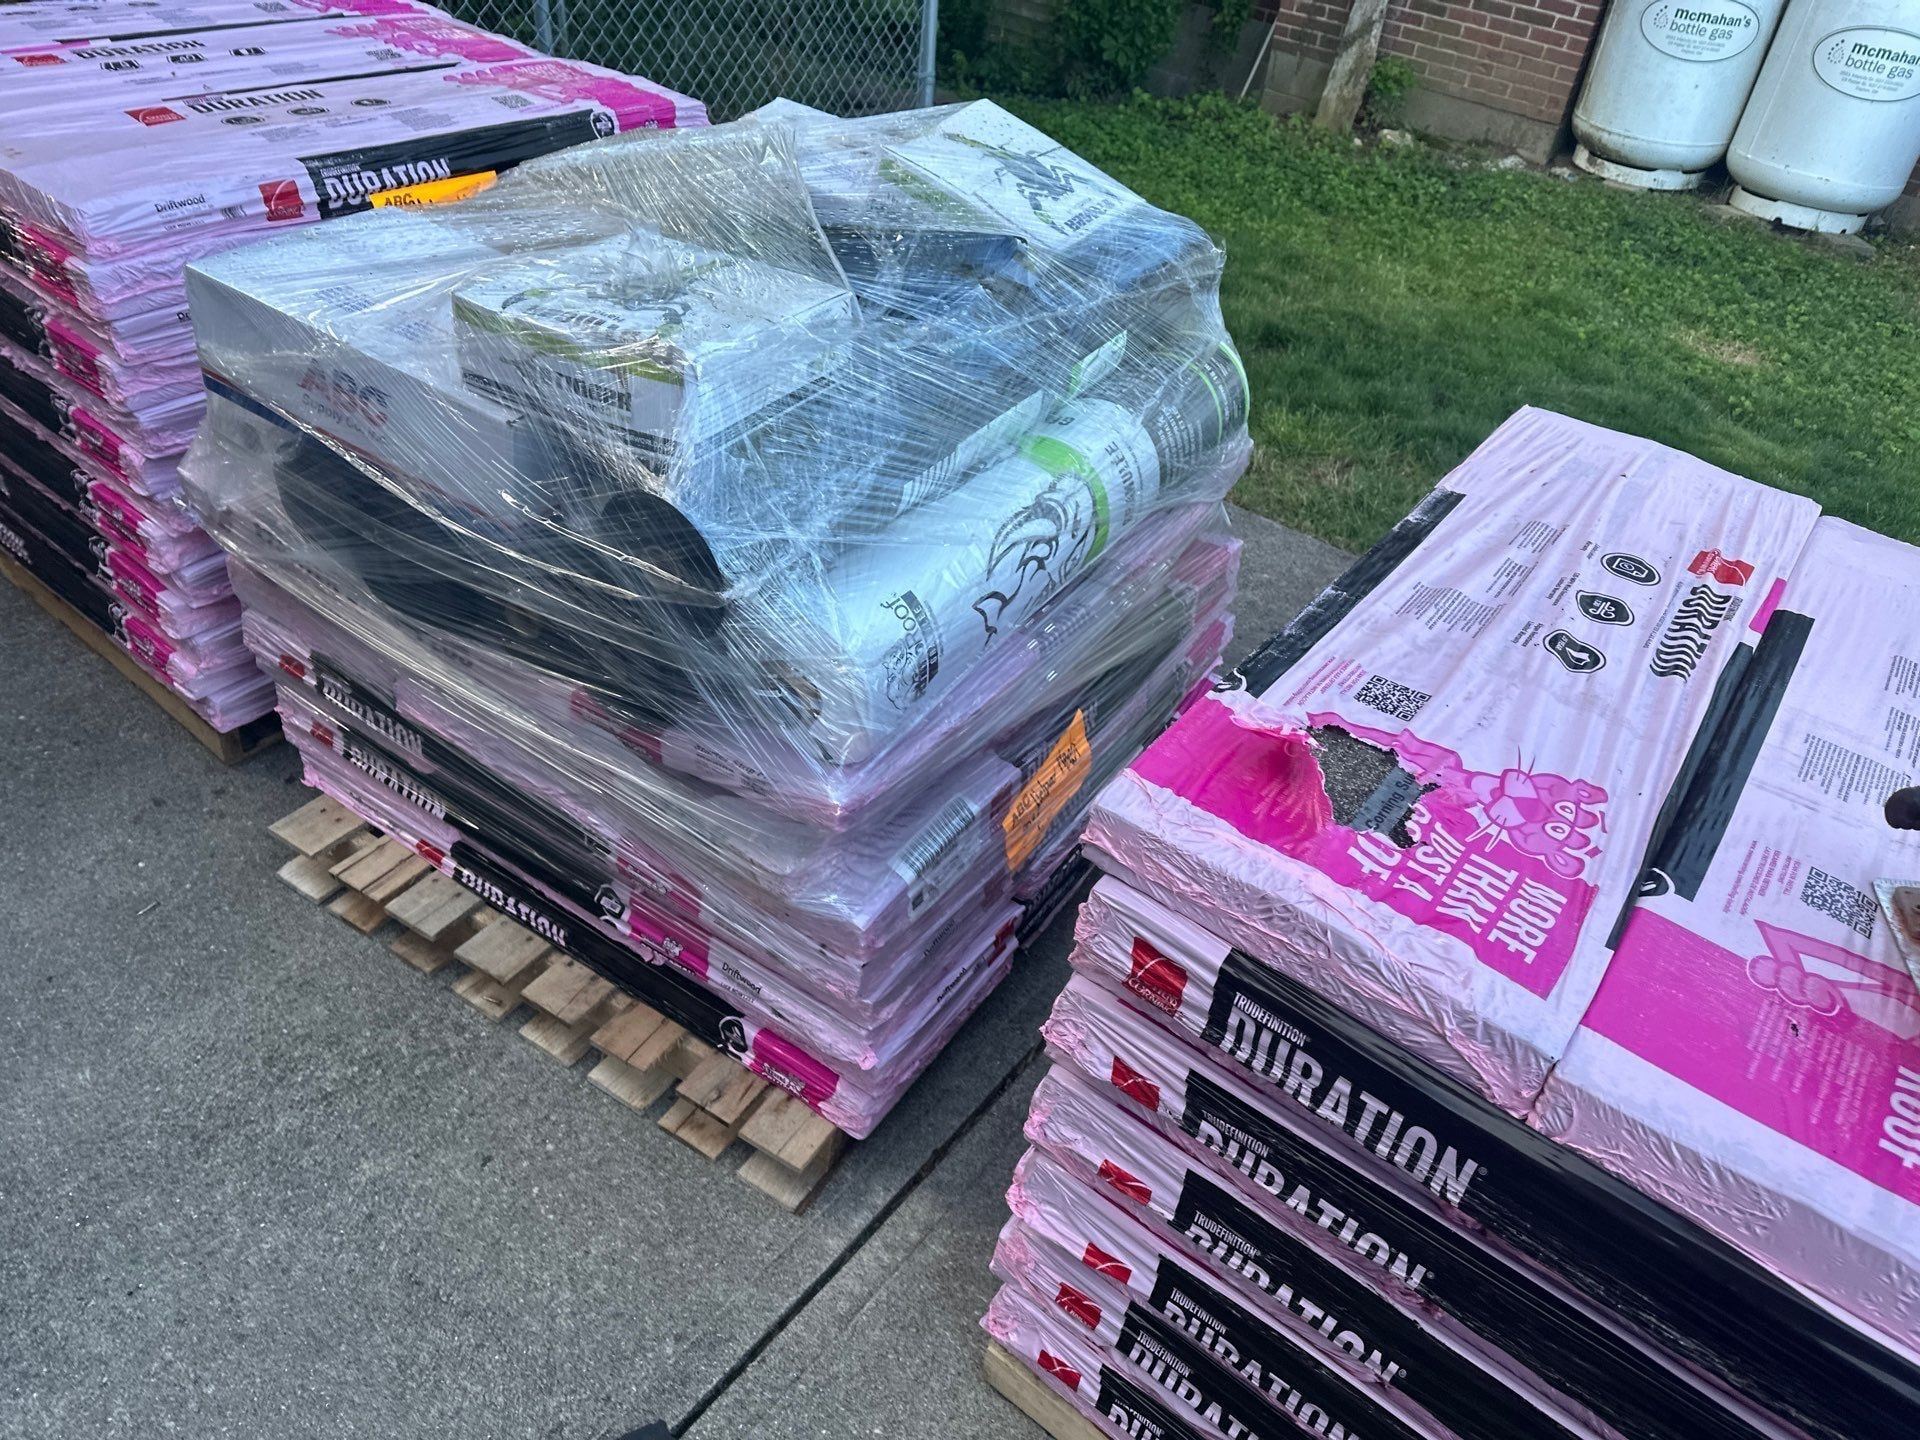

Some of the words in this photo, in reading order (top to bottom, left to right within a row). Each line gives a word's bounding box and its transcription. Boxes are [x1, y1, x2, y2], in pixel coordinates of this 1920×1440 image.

[1669, 20, 1707, 37] bottle
[1708, 27, 1734, 41] gas
[1674, 8, 1752, 28] mcmahan's
[1845, 54, 1886, 74] bottle
[1886, 65, 1914, 80] gas
[188, 88, 326, 114] DURATION
[153, 193, 207, 213] Driftwood
[322, 157, 451, 210] DURATION
[1649, 584, 1732, 683] DURATION
[322, 675, 424, 757] DURATION
[350, 744, 448, 820] DURATION
[1365, 791, 1405, 830] Corning
[1406, 821, 1466, 887] JUST
[461, 867, 567, 947] DURATION
[1393, 873, 1434, 903] A
[1436, 853, 1520, 935] THAN
[1486, 877, 1568, 965] MORE
[721, 960, 763, 996] Driftwood
[1233, 991, 1307, 1048] TRUDEFINITION
[1218, 1007, 1479, 1210] DURATION
[1202, 1110, 1271, 1159] TRUDEFINITION
[1196, 1119, 1427, 1291] DURATION
[1194, 1209, 1258, 1257] TRUDEFINITION
[1170, 1287, 1228, 1336] TRUDEFINITION
[1136, 1329, 1191, 1379] TRUDEFINITION
